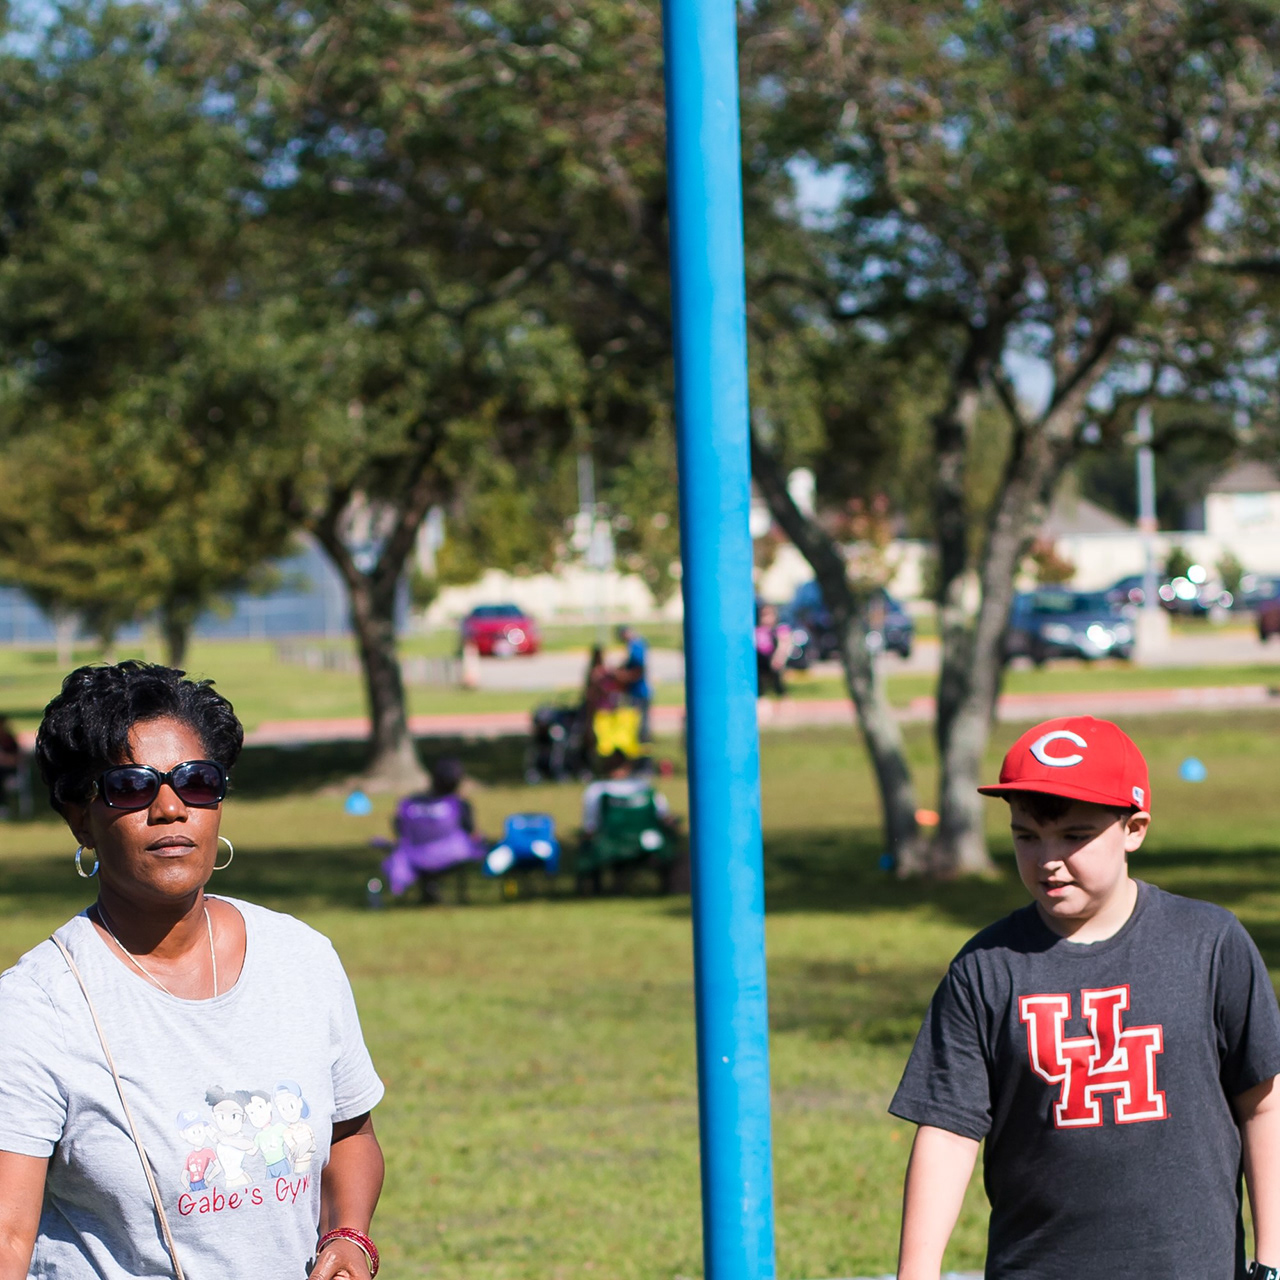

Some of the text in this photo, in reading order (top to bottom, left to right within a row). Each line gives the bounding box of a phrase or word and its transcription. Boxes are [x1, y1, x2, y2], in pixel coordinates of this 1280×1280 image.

[1029, 730, 1087, 767] C
[1018, 983, 1167, 1129] UH
[178, 1187, 263, 1216] Gabe's
